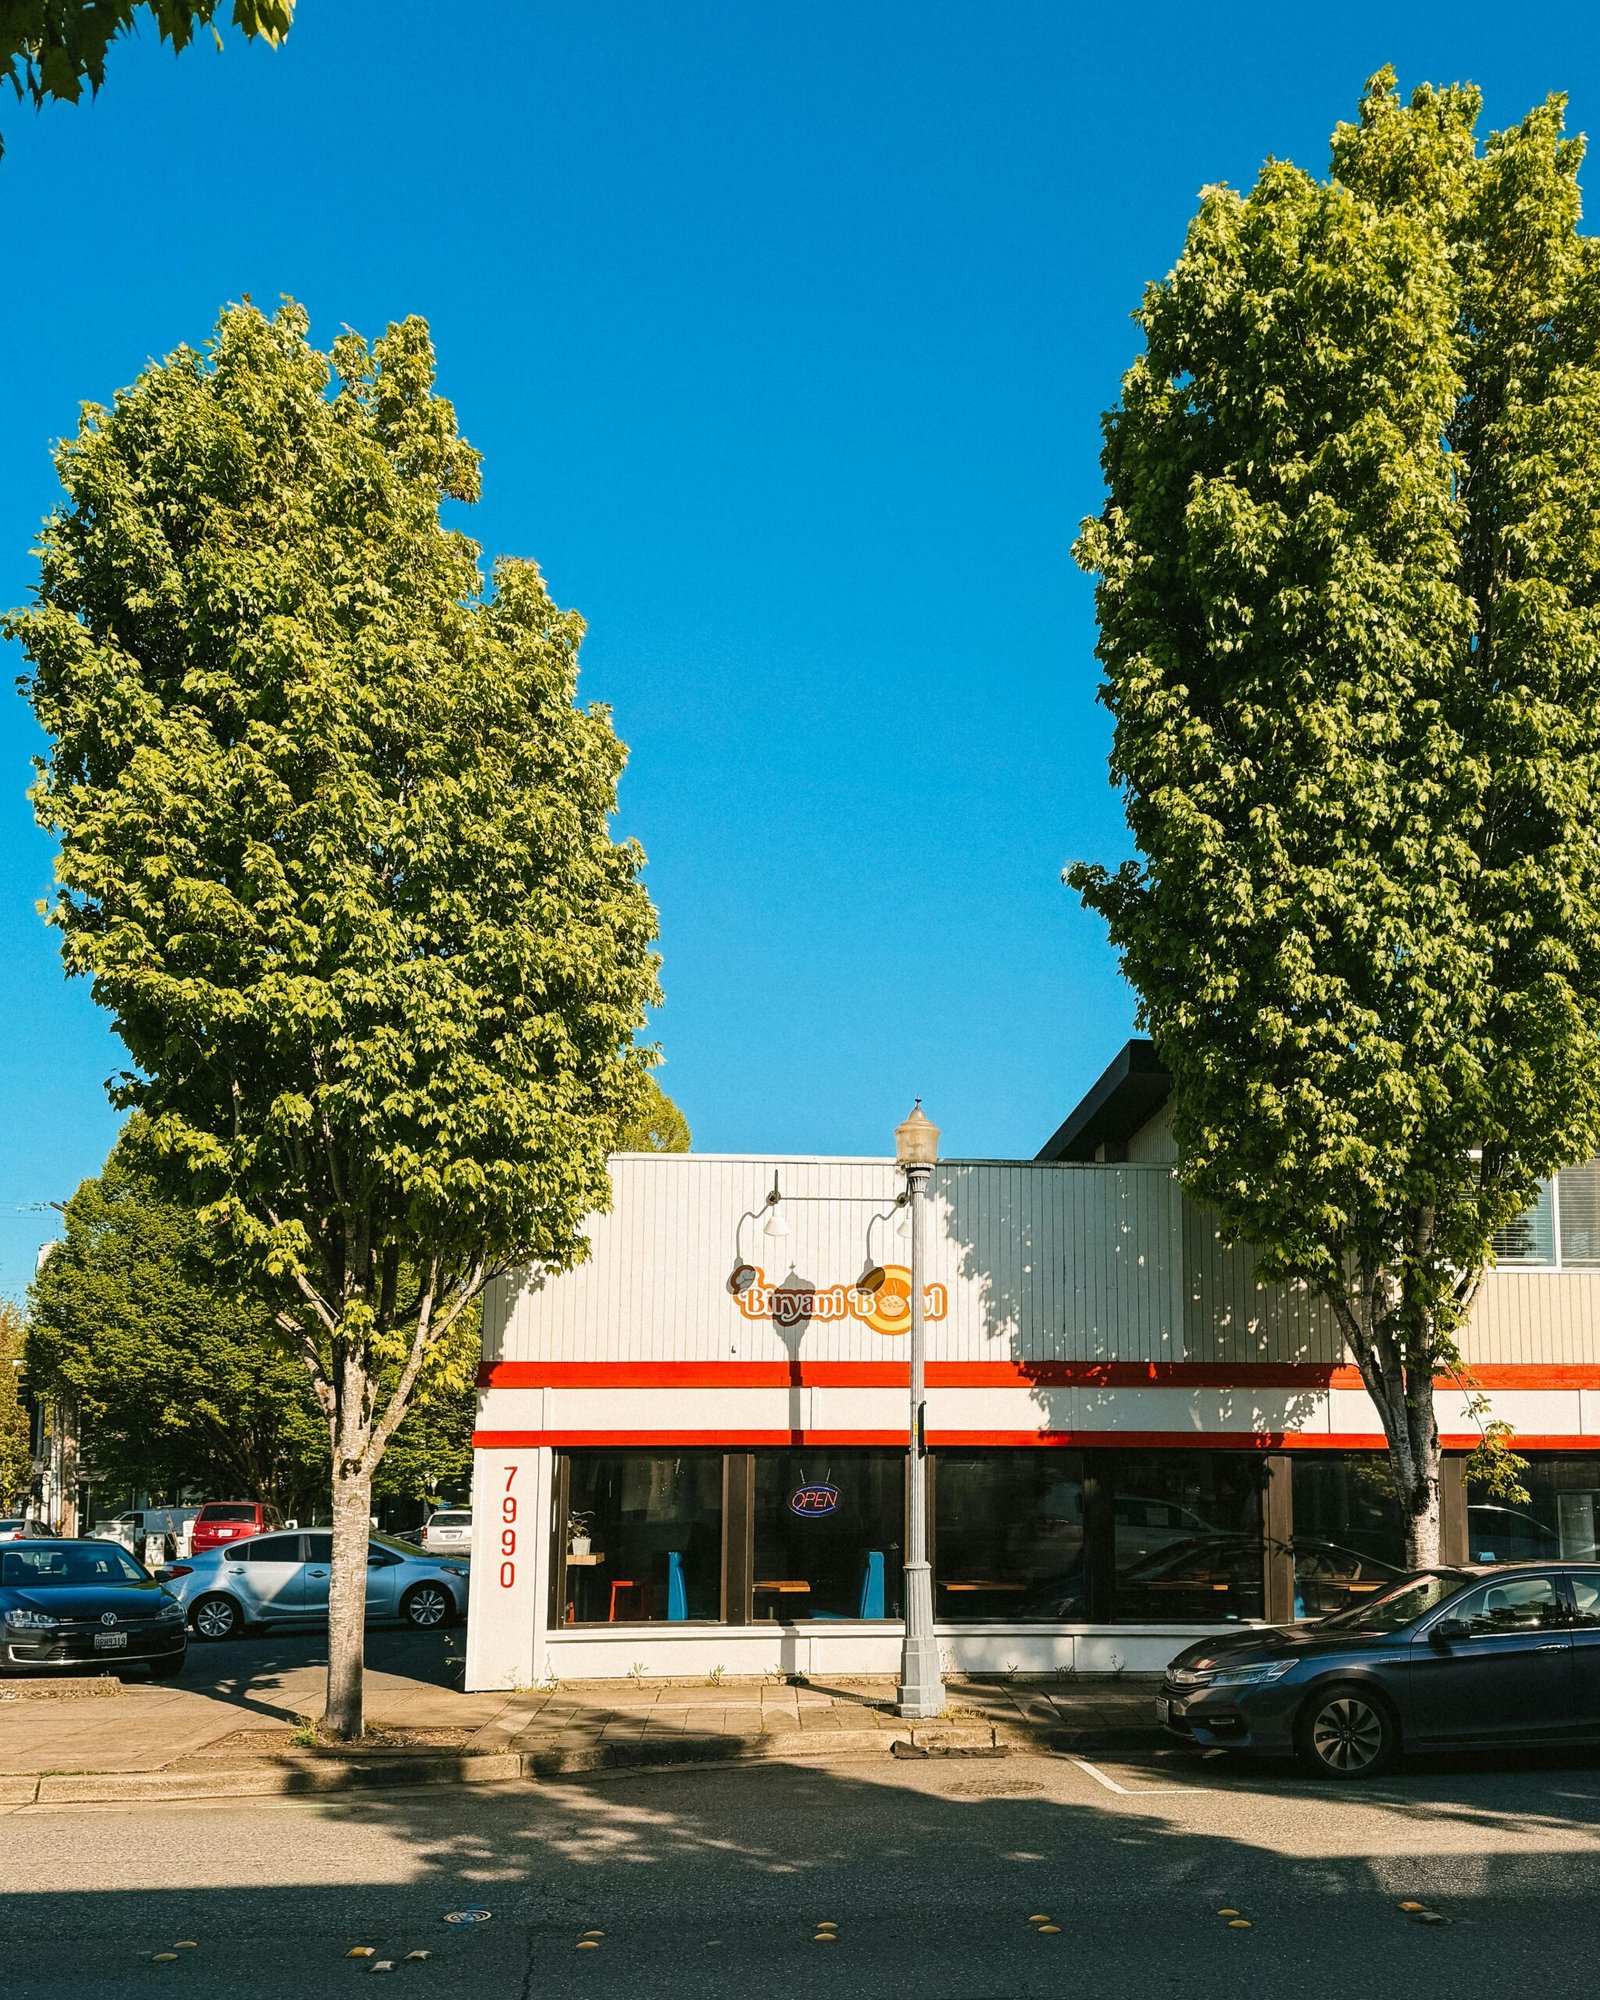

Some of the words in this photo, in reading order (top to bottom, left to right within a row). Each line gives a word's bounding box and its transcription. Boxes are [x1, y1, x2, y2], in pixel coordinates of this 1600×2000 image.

[736, 1285, 845, 1324] Biryani
[791, 1491, 838, 1508] OPEN
[500, 1466, 518, 1589] 7990
